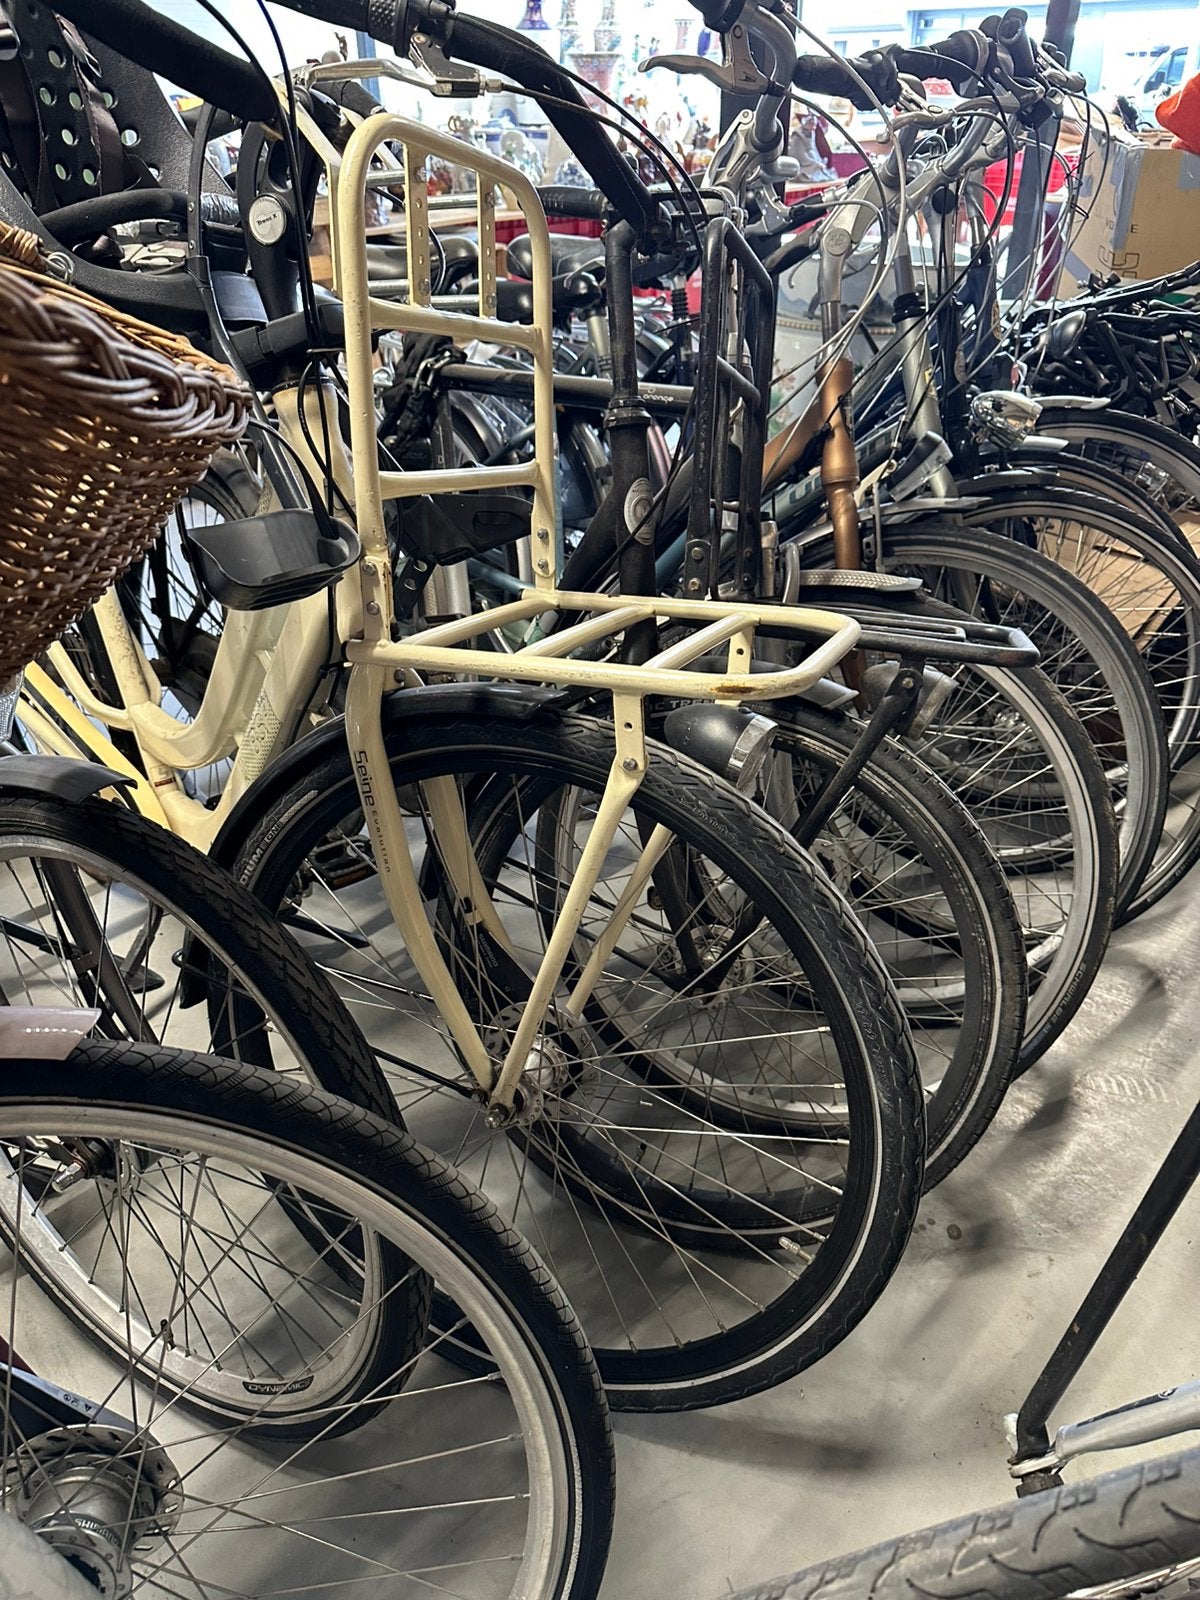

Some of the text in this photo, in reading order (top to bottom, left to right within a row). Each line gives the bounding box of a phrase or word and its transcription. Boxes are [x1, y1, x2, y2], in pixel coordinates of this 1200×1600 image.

[642, 393, 674, 404] orange
[353, 750, 391, 873] Seine Evolution
[1050, 961, 1087, 1024] SCHWALBE
[248, 1382, 305, 1393] DYNAMIC
